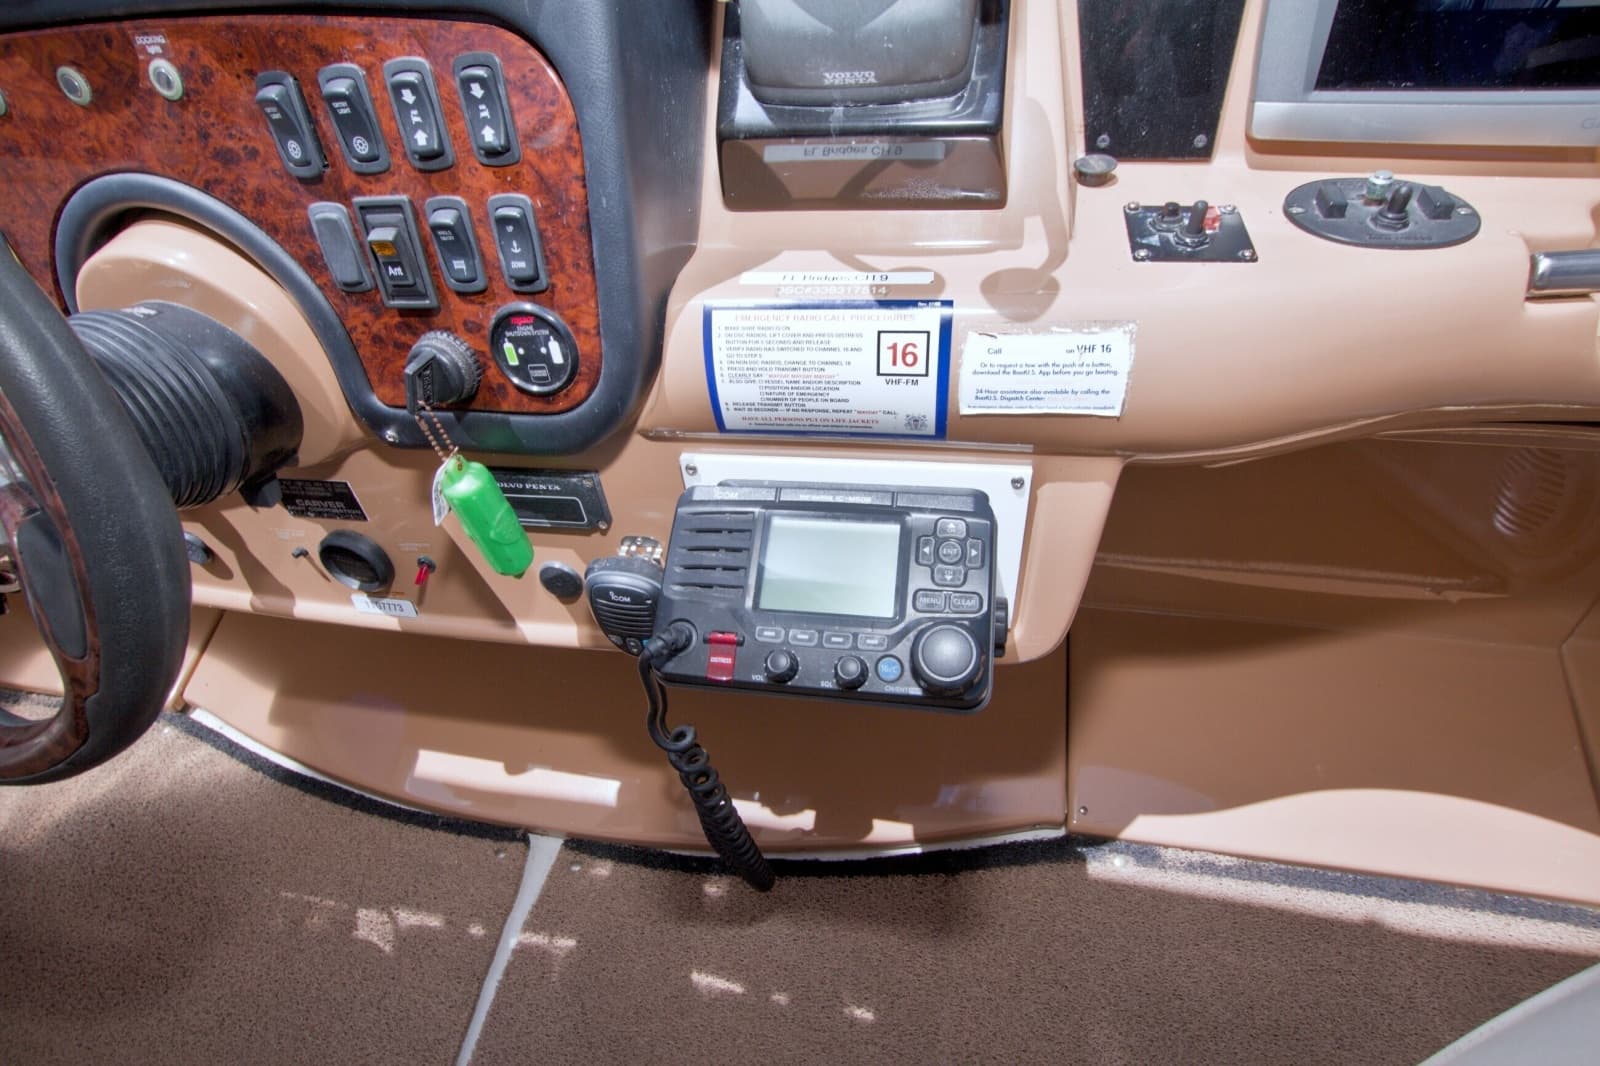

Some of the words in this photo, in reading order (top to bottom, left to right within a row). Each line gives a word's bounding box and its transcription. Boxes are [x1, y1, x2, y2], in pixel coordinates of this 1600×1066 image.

[823, 71, 875, 80] VOLVO
[793, 313, 822, 322] RADIO
[825, 313, 847, 322] CALL
[987, 347, 1002, 355] Call
[1076, 344, 1097, 353] VHF
[1100, 344, 1112, 353] 16
[885, 342, 919, 368] 16
[1038, 369, 1051, 377] App
[884, 378, 920, 386] VHF-FM
[1079, 388, 1100, 396] calling
[295, 499, 345, 508] CARVER
[710, 656, 733, 664] DISTRESS
[752, 674, 764, 682] VOL
[820, 680, 833, 688] SQL
